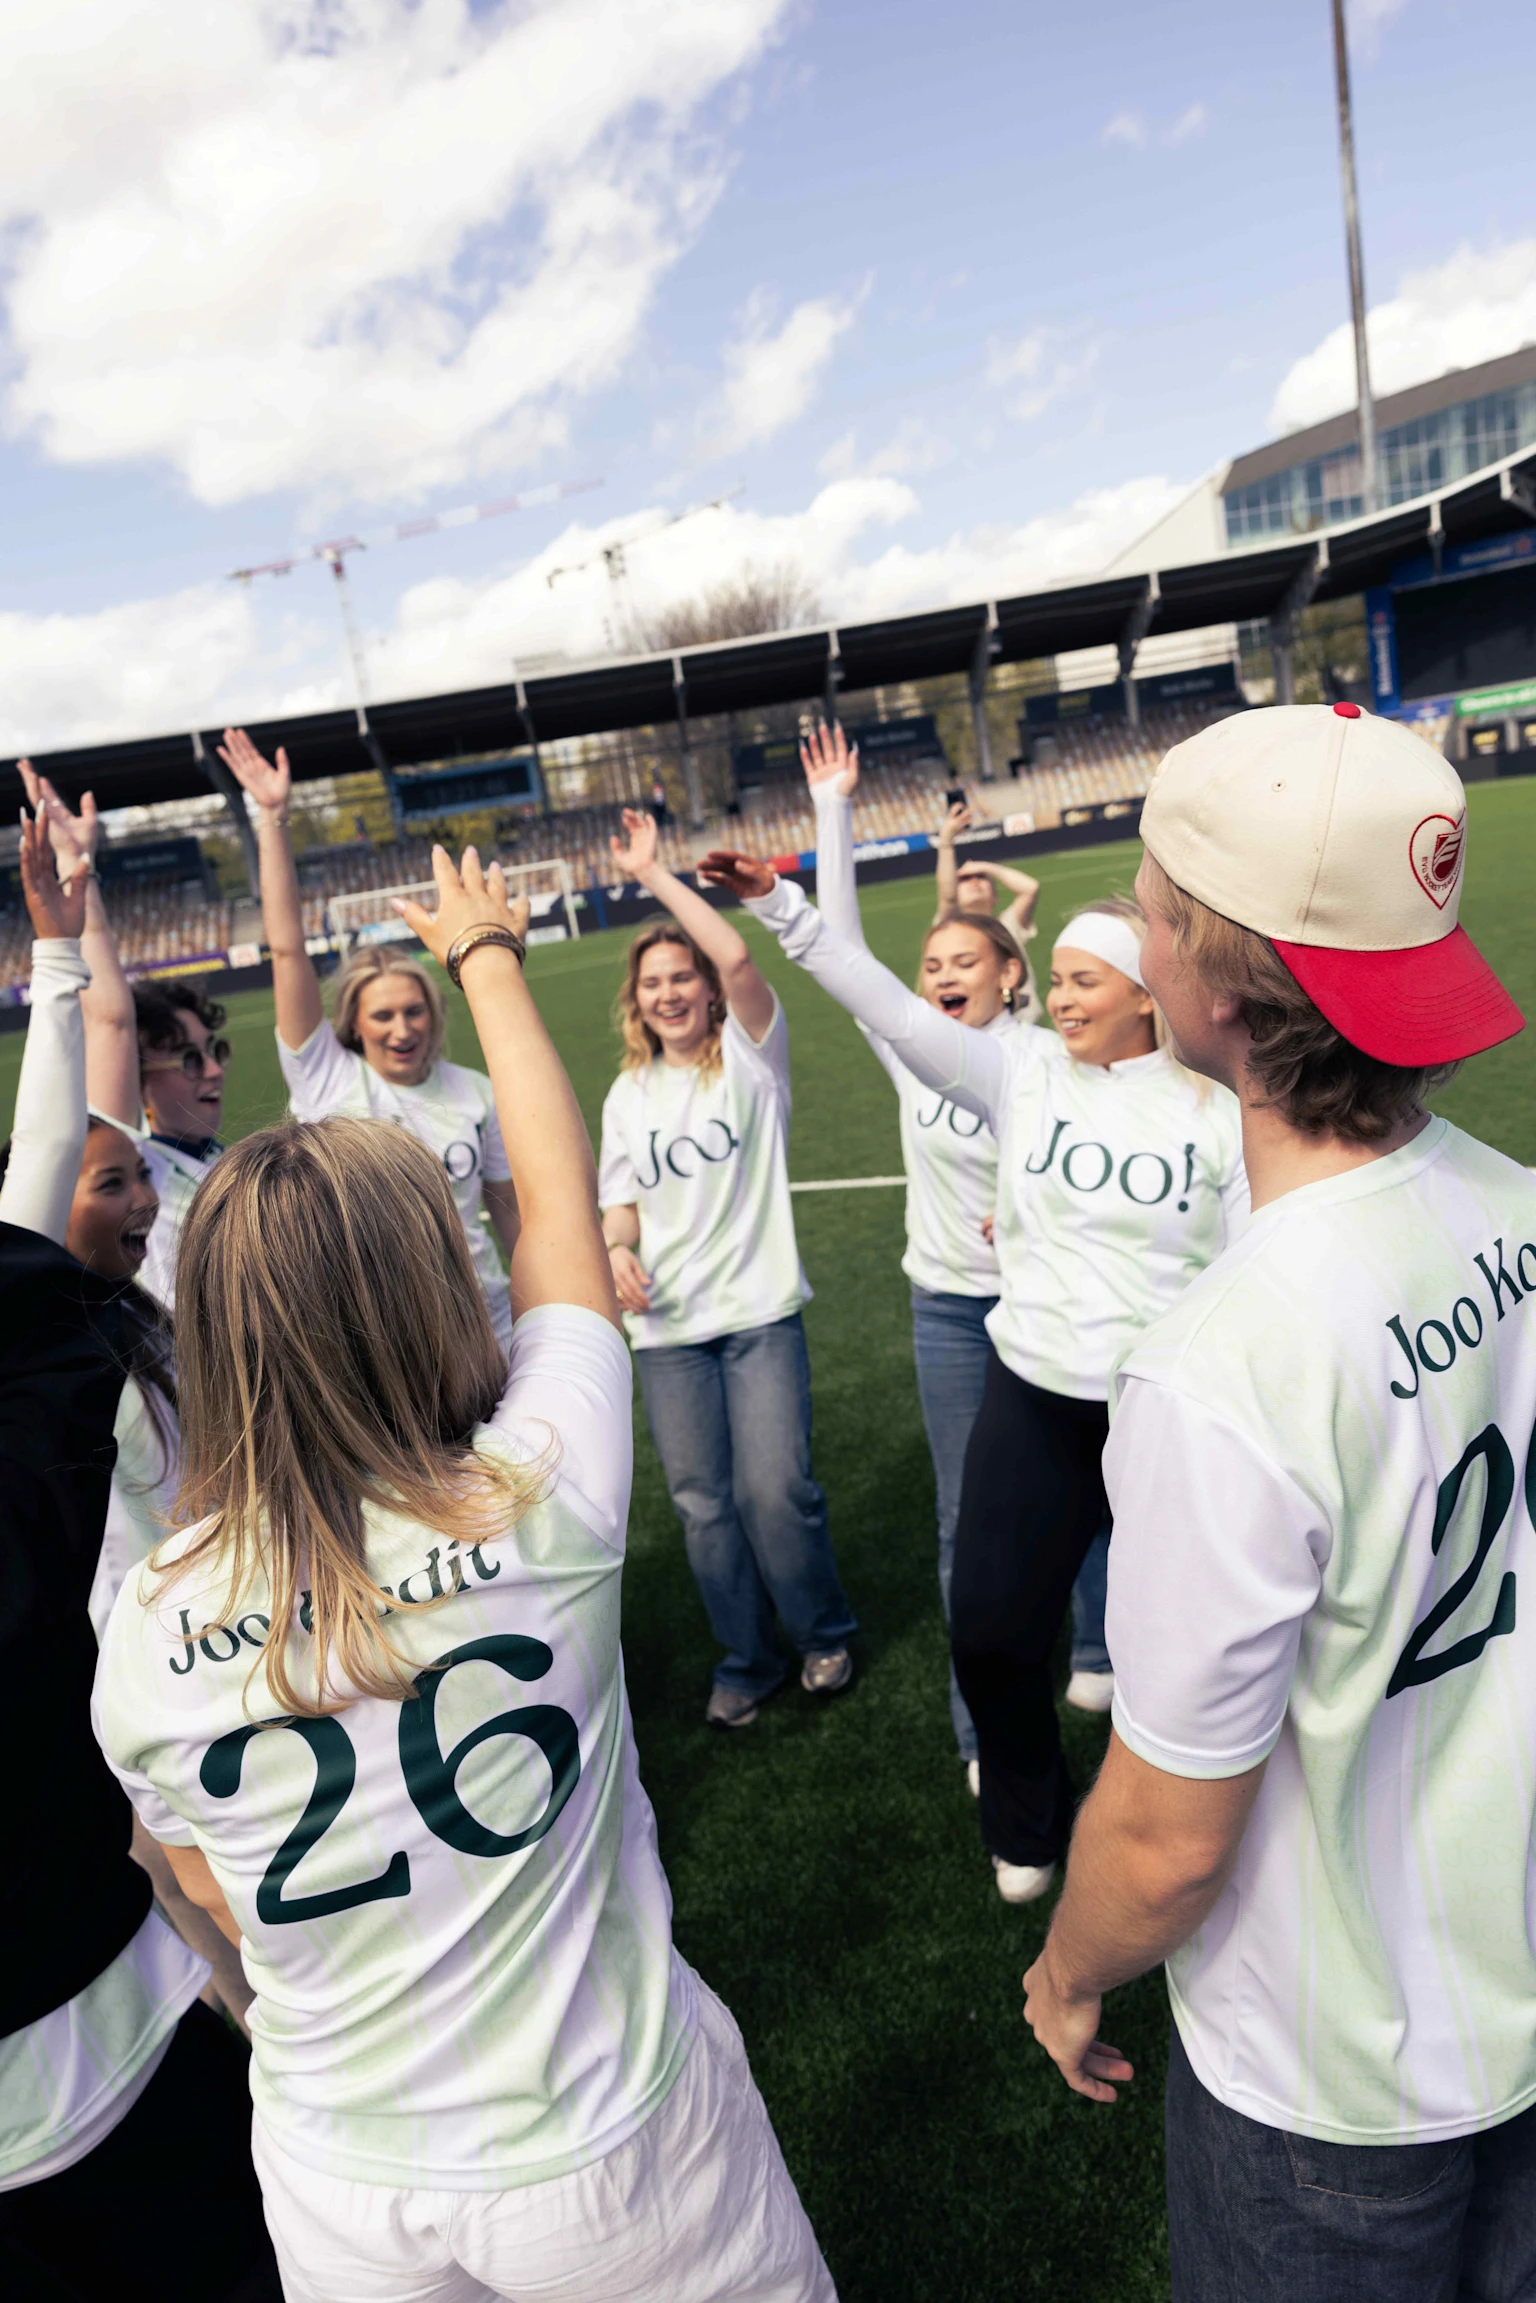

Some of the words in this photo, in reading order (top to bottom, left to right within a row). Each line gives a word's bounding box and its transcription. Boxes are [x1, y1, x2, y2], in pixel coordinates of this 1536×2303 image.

[1025, 1117, 1196, 1212] JOO!
[1385, 1313, 1483, 1400] Joo
[1385, 1416, 1536, 1699] 2
[168, 1608, 281, 1676] Joo
[199, 1633, 582, 1925] 26
